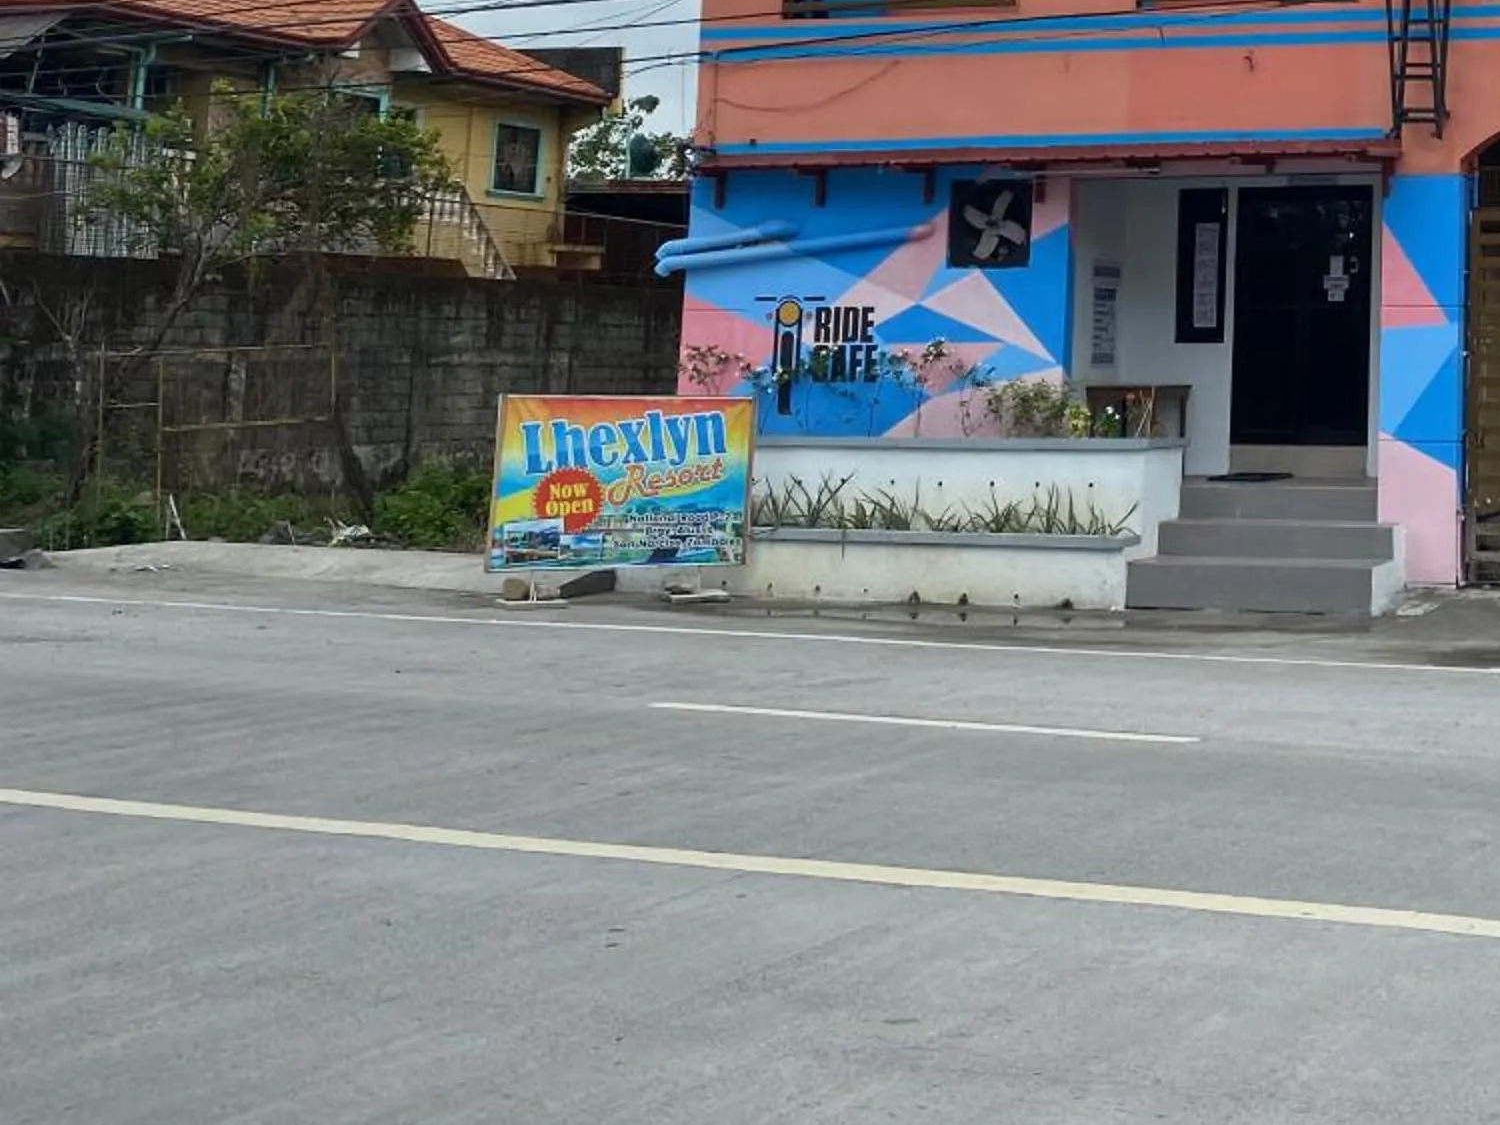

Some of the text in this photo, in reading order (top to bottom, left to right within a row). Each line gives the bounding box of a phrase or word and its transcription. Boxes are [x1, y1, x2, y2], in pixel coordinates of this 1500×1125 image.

[814, 306, 875, 343] RIDE
[521, 410, 727, 475] Lhexlyn
[549, 482, 588, 500] Now
[606, 457, 723, 505] Resort
[545, 497, 593, 517] Open
